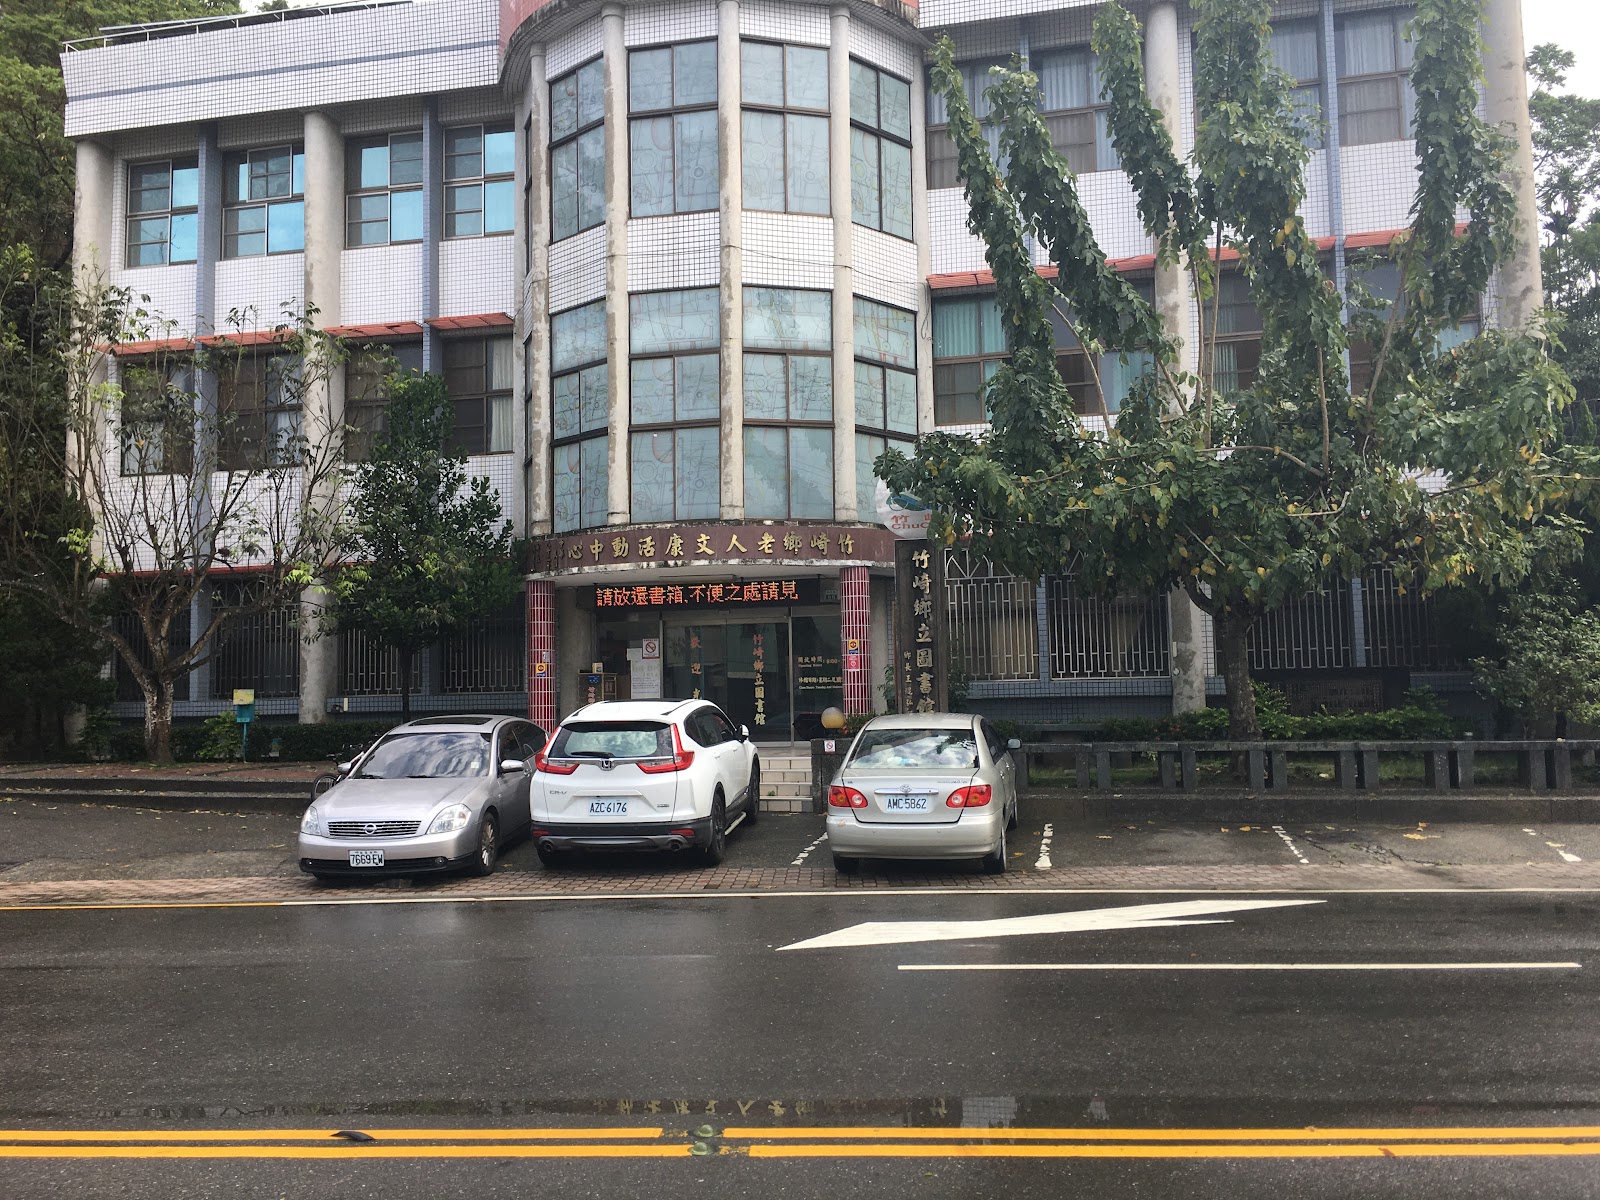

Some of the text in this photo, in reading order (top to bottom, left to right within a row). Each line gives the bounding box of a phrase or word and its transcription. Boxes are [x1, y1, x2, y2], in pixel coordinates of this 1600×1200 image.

[911, 549, 936, 714] 竹崎鄉立圖書館
